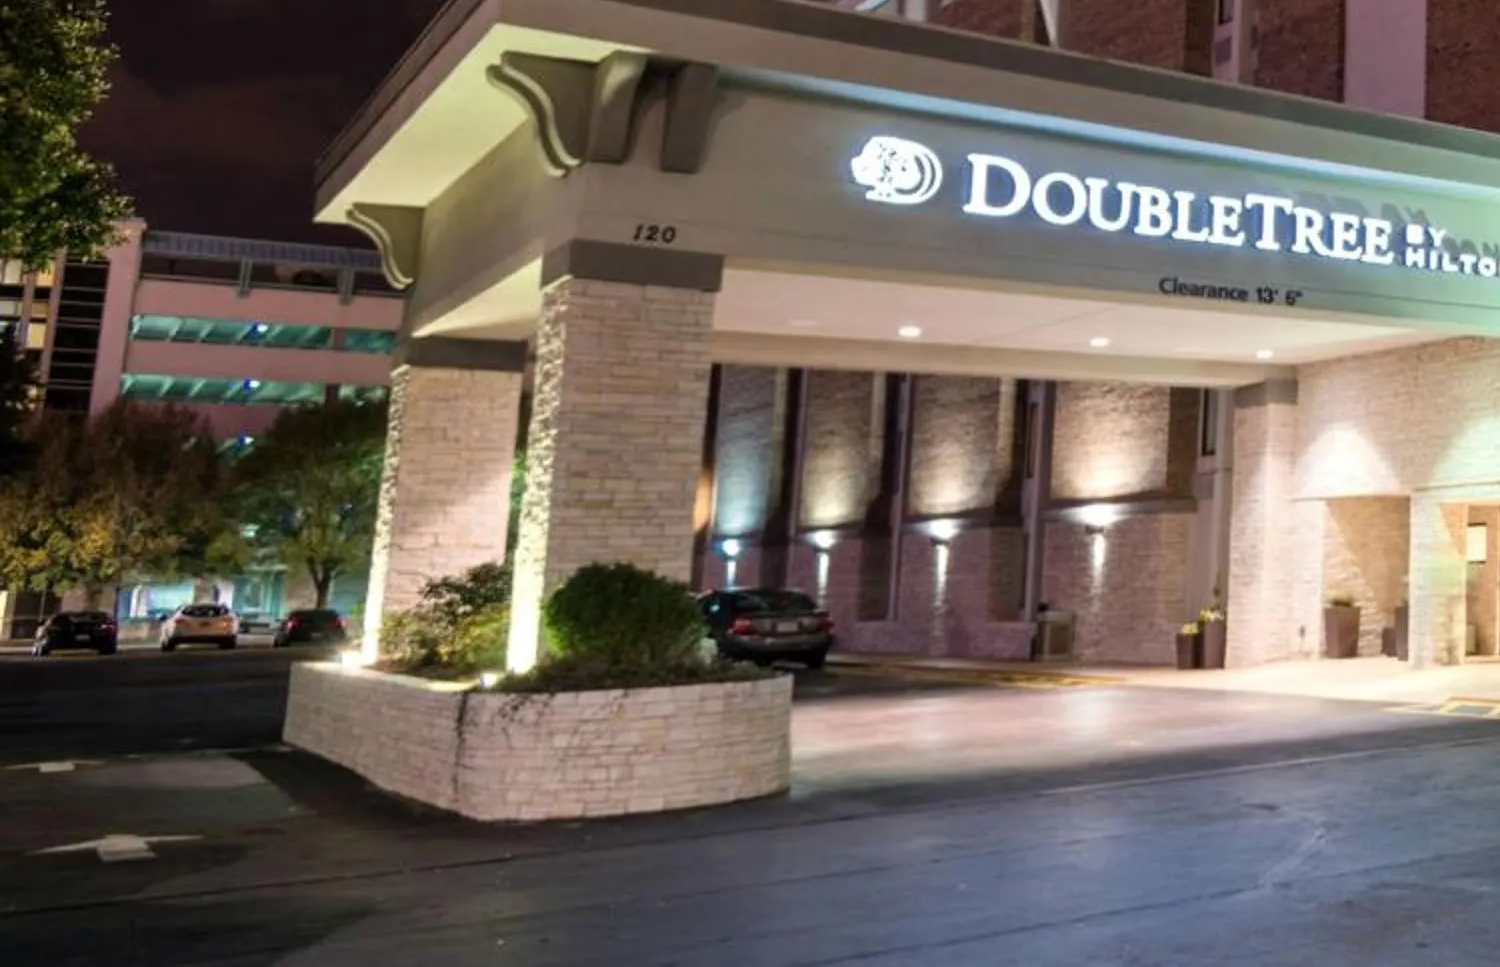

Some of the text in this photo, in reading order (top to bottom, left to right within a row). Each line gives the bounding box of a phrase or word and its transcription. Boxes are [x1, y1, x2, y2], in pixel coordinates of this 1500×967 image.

[962, 152, 1396, 266] DOUBLETREE
[633, 224, 677, 244] 120
[1406, 223, 1447, 248] BY
[1158, 276, 1249, 302] Clearance
[1256, 285, 1279, 305] 13'
